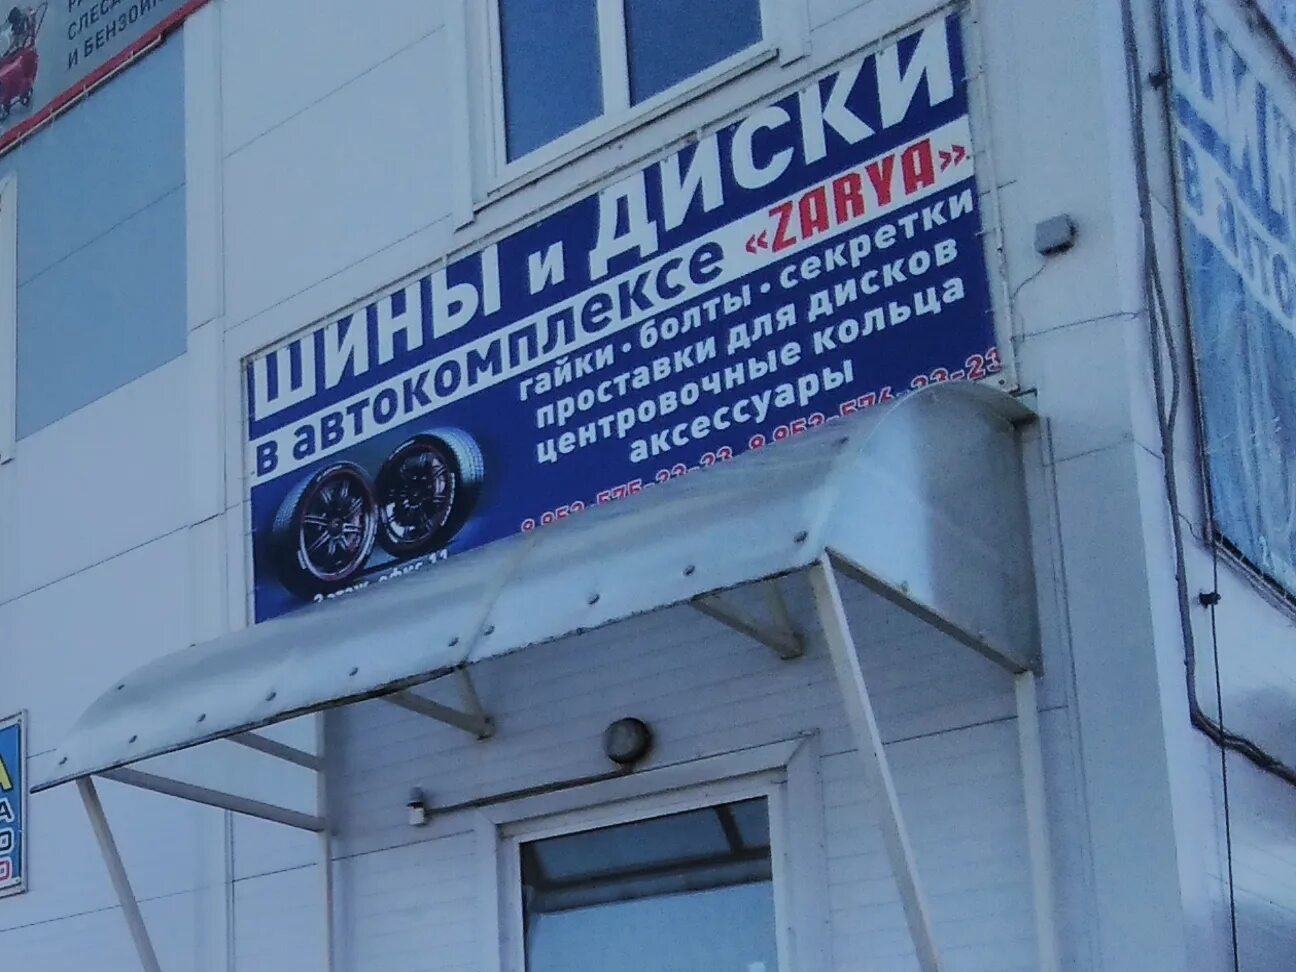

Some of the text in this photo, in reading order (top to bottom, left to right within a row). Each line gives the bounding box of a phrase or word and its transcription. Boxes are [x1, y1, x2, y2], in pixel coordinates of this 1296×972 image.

[68, 0, 158, 69] И БЕНЗОИ
[254, 14, 955, 422] ШИНЫ и ДИСКИ
[745, 138, 967, 255] «ZARYA»
[256, 241, 724, 477] в автокомплексе
[519, 189, 973, 400] гайки болты секретки
[536, 238, 958, 428] проставки для дисков
[537, 277, 965, 464] центровочные кольца
[629, 359, 854, 464] аксессуары
